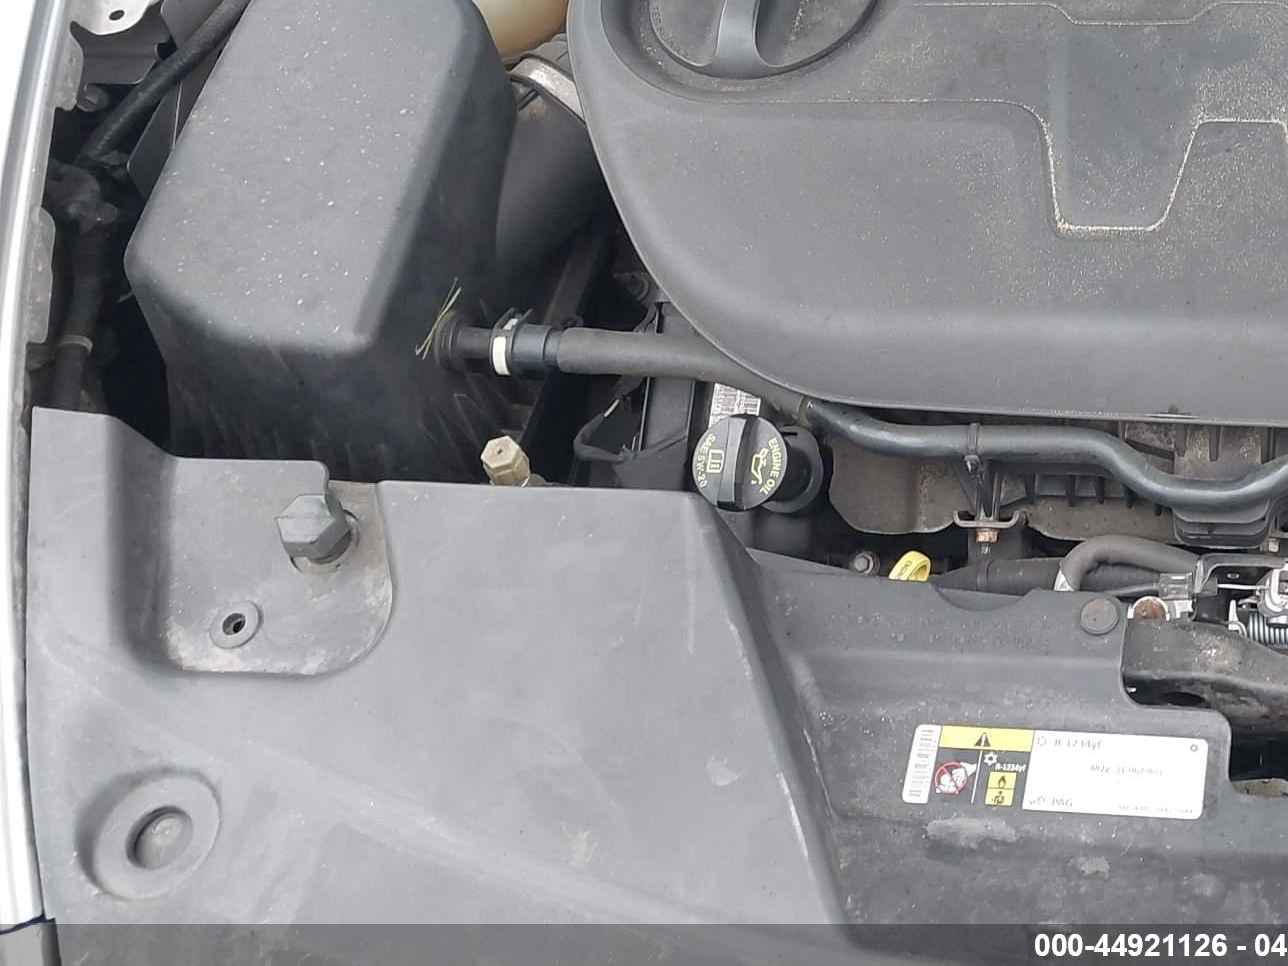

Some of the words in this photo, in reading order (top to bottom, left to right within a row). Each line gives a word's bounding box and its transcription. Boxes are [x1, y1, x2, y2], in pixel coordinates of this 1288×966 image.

[698, 433, 717, 455] SAE
[767, 437, 783, 479] ENGINE
[695, 455, 708, 489] 5W-20
[759, 478, 777, 496] OIL
